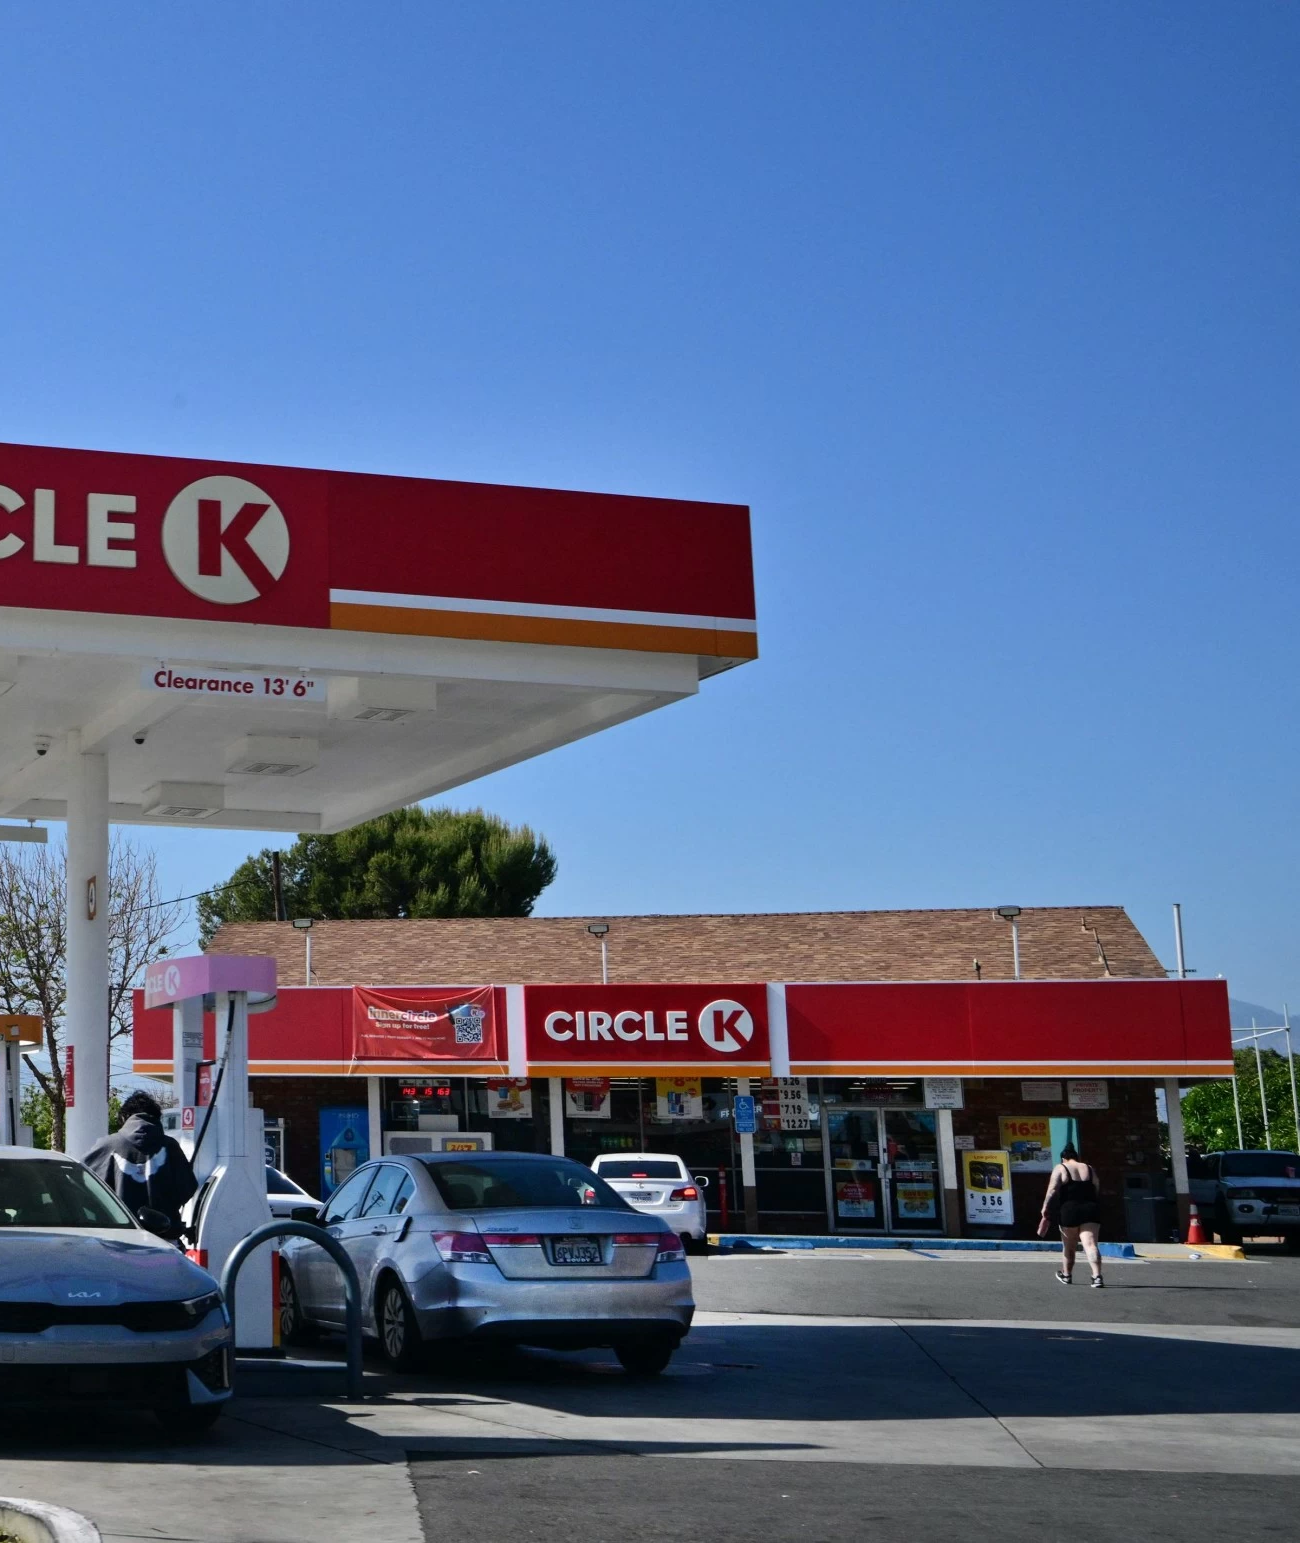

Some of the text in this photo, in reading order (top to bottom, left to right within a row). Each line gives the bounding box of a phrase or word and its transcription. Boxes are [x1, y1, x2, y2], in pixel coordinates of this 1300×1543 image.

[153, 669, 255, 695] Clearance
[375, 1021, 391, 1030] Sign
[402, 1022, 413, 1030] for
[544, 1010, 689, 1042] CIRCLE
